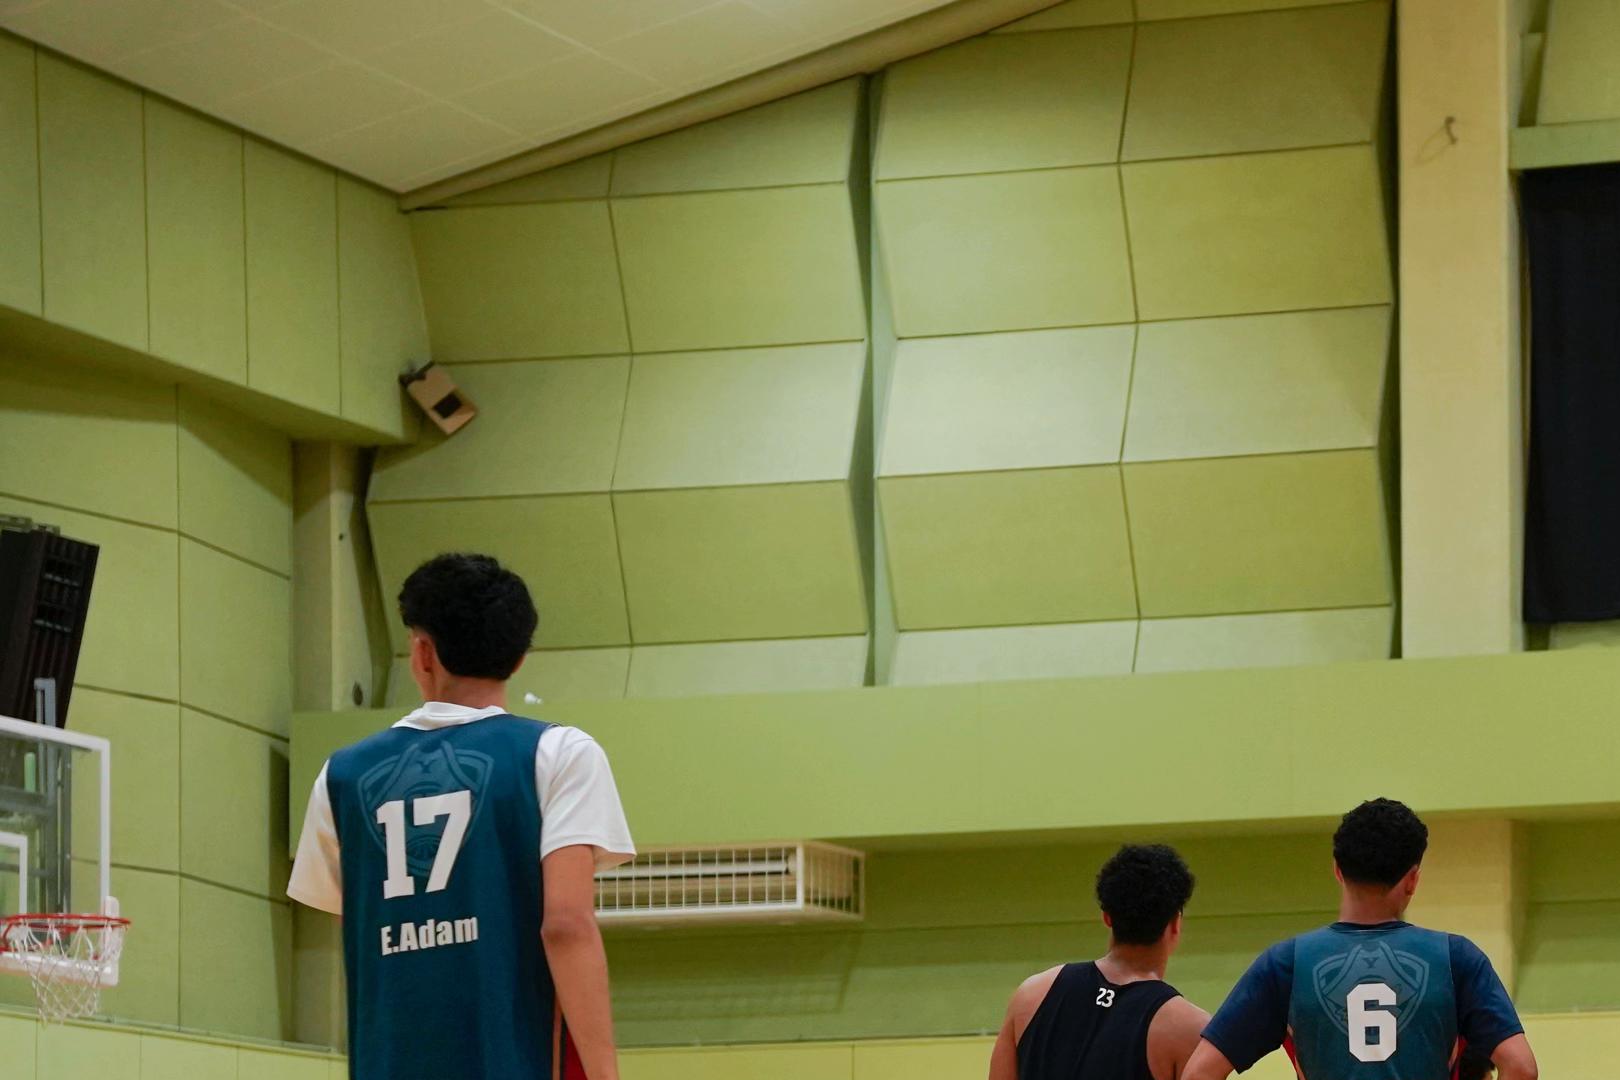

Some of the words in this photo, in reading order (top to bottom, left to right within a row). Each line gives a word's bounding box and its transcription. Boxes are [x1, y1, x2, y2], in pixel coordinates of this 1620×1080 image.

[376, 789, 471, 900] 17
[380, 916, 479, 957] E.Adam
[1096, 987, 1115, 1008] 23
[1346, 982, 1397, 1062] 6
